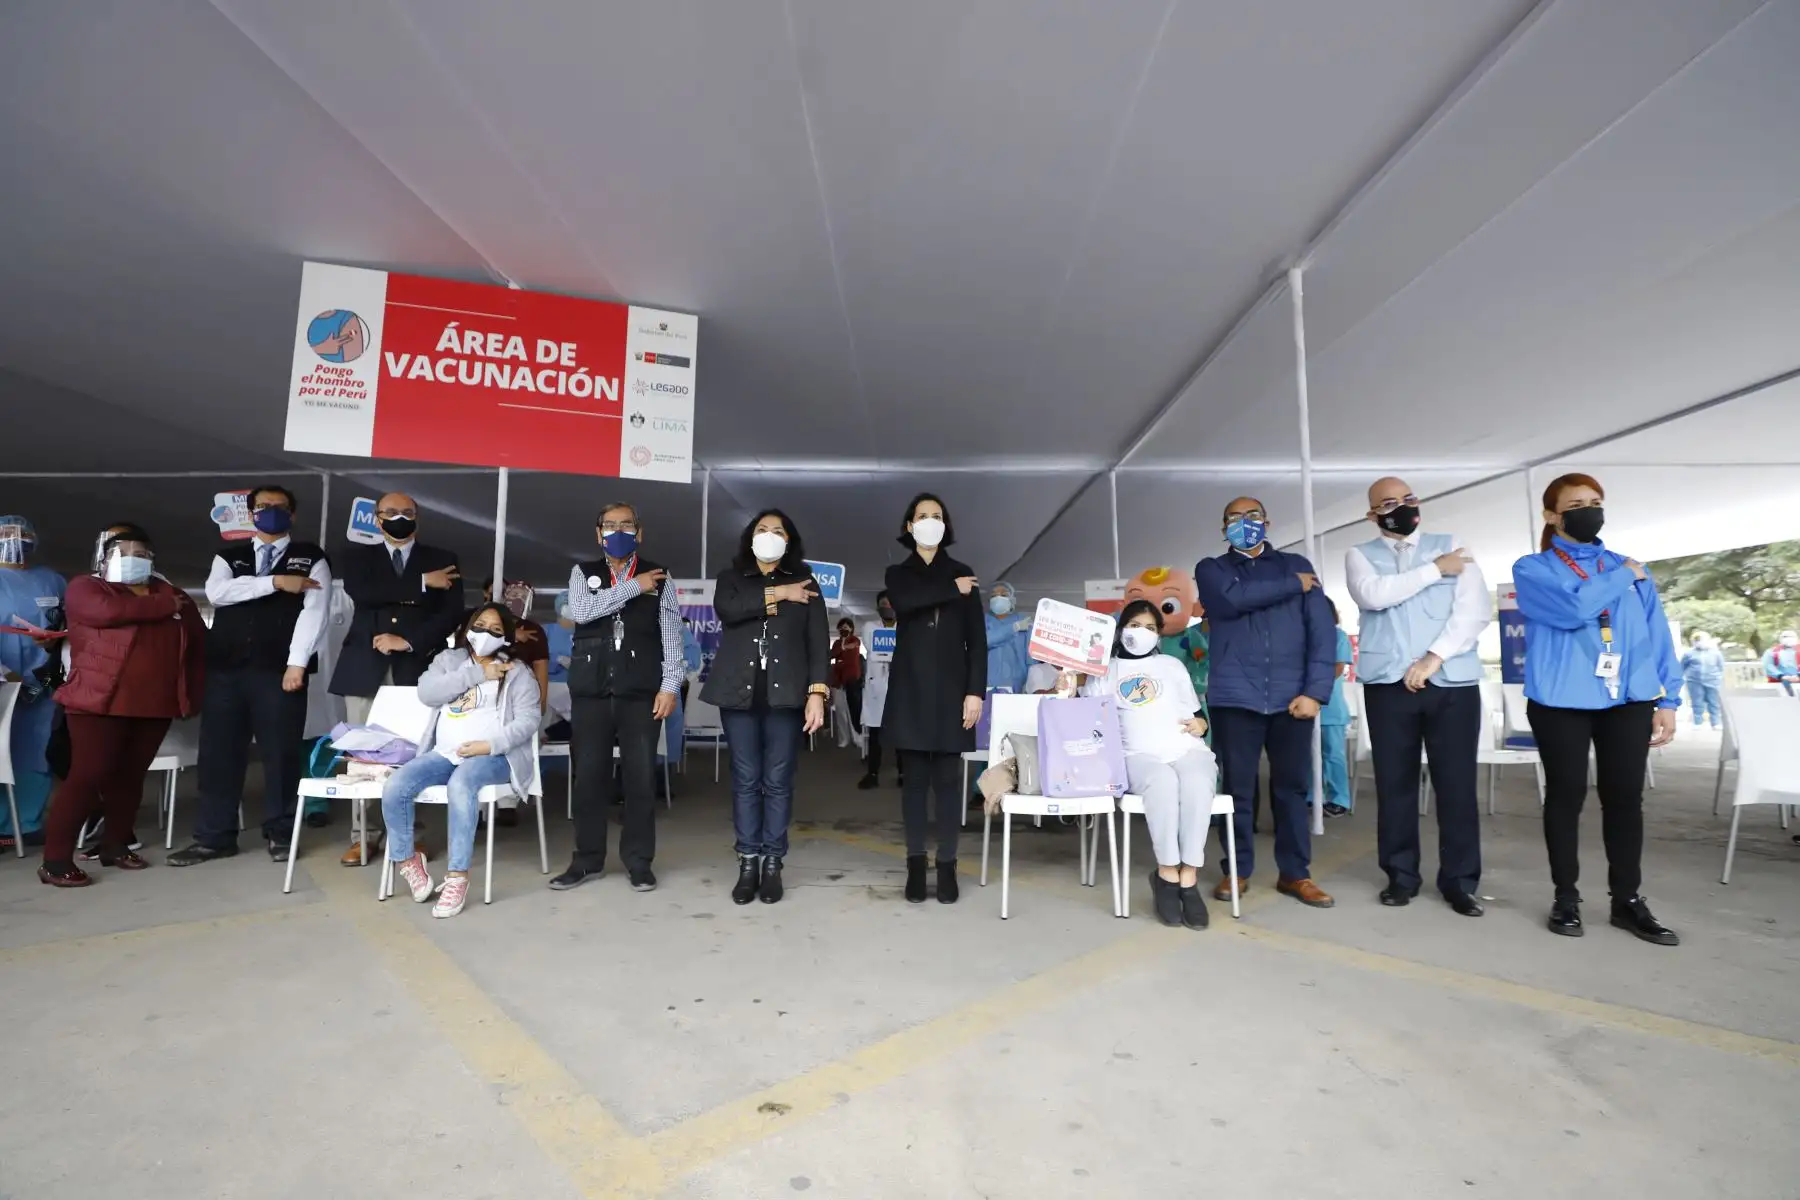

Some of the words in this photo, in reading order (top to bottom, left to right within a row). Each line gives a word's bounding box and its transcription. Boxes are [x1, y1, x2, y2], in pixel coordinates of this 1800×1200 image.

[435, 321, 528, 362] ÁREA
[536, 339, 577, 367] DE
[314, 364, 354, 378] Pongo
[384, 351, 619, 401] VACUNACIÓN
[301, 374, 314, 384] el
[315, 374, 365, 388] hombro
[298, 386, 322, 397] por
[324, 387, 337, 397] el
[338, 388, 368, 400] Perú
[329, 402, 360, 410] VACUNO
[652, 420, 688, 433] LIMA
[811, 572, 838, 588] NSA
[874, 636, 897, 648] MIN
